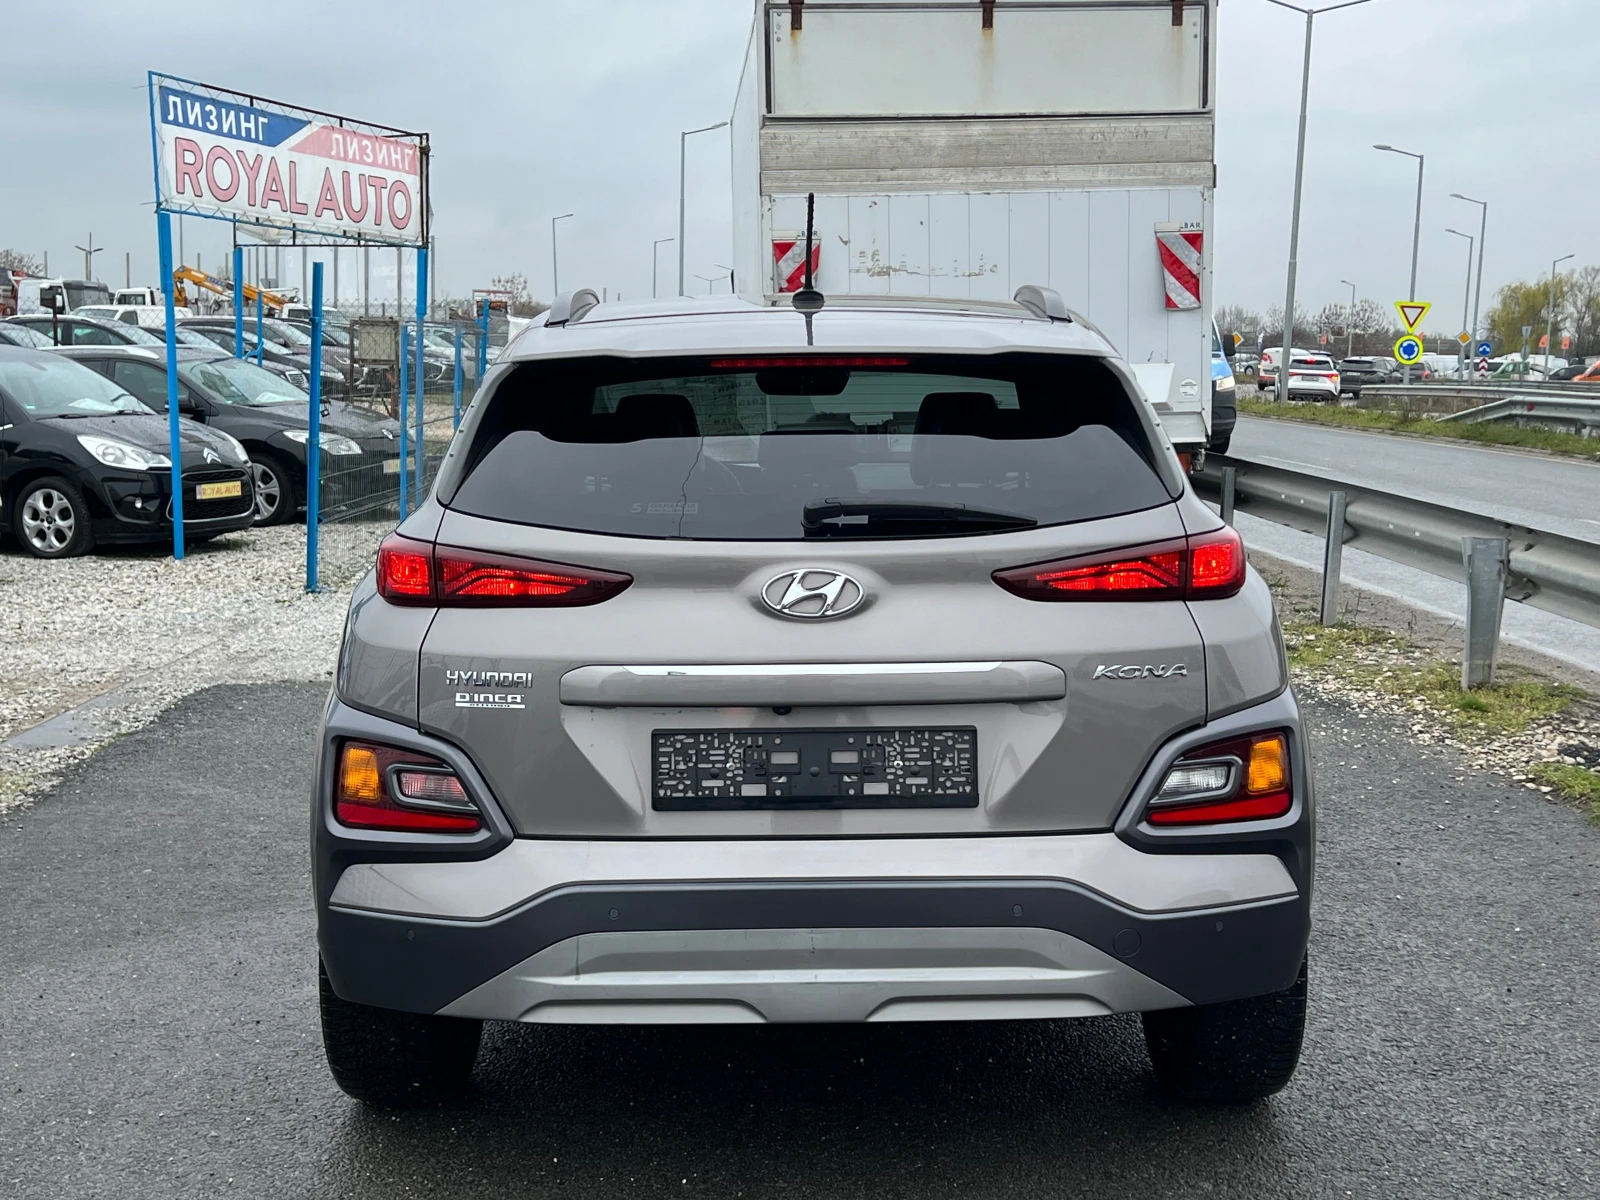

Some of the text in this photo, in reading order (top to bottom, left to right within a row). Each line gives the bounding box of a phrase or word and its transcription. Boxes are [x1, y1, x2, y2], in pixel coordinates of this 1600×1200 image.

[167, 95, 269, 142] ЛИЗИНГ
[331, 133, 413, 172] ЛИЗИНГ
[175, 137, 412, 229] ROYAL AUTO
[202, 484, 241, 496] ROYAL AUTO
[446, 670, 533, 688] HYUNDAI
[1092, 663, 1188, 680] KONA
